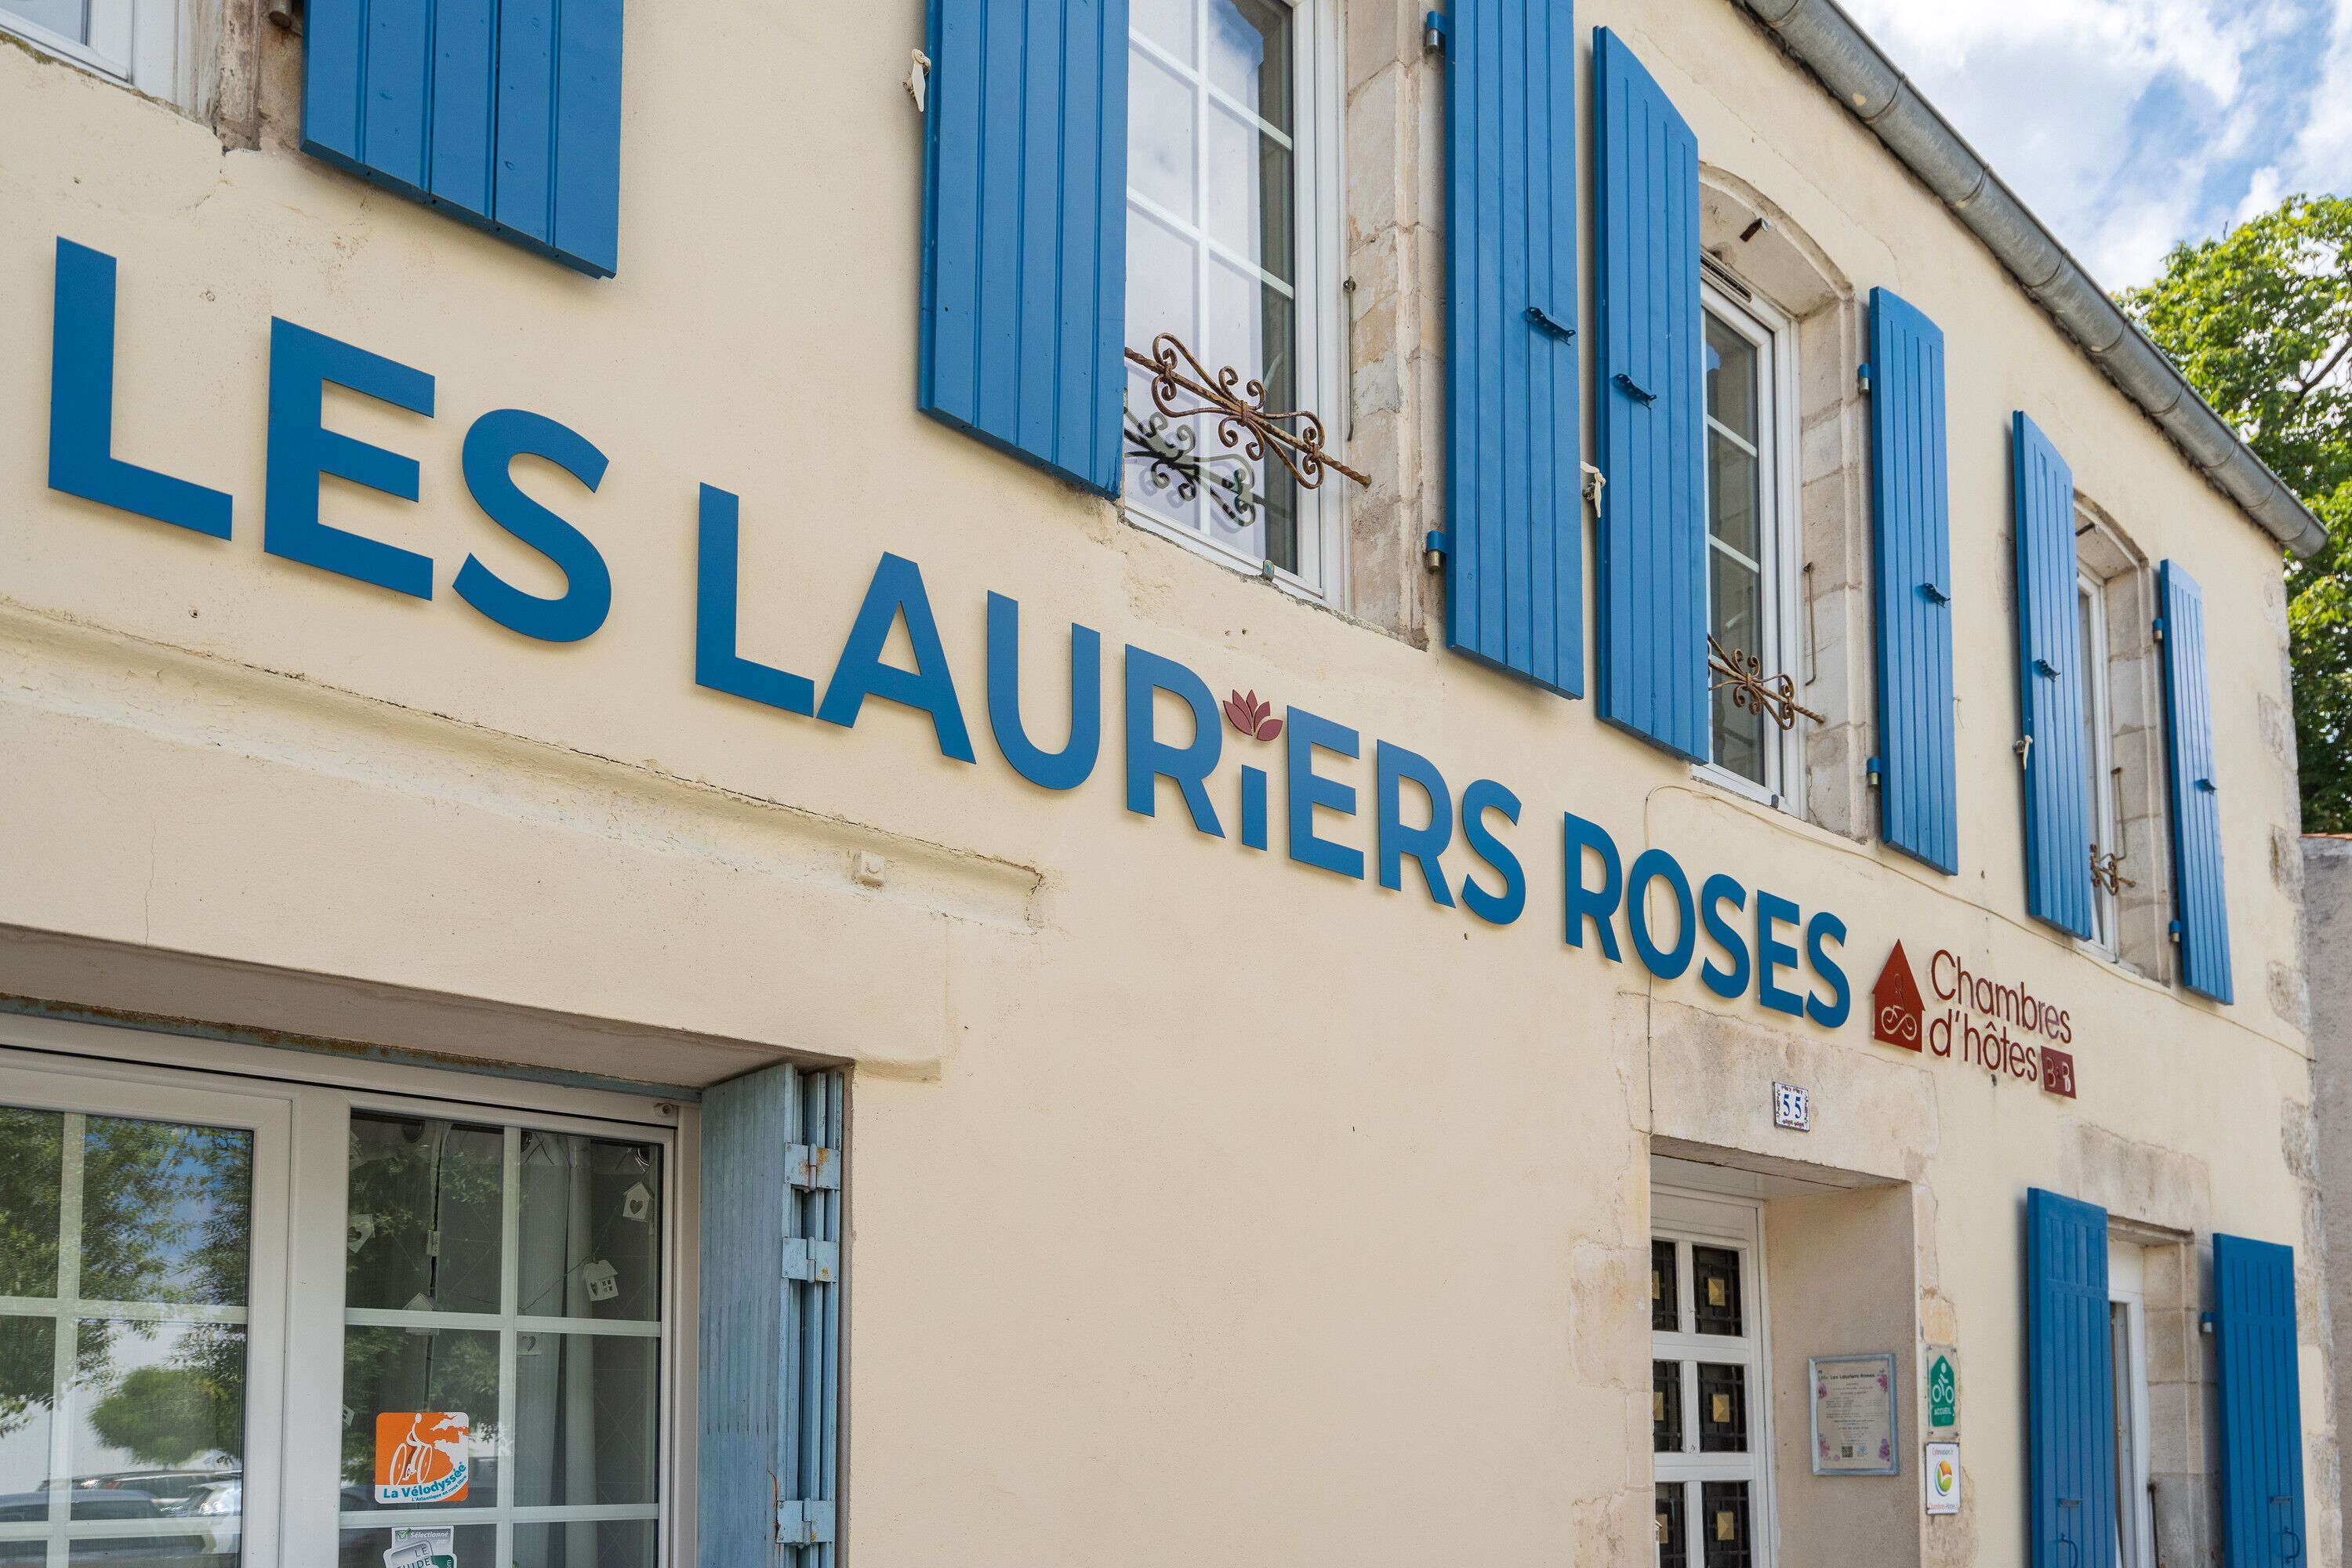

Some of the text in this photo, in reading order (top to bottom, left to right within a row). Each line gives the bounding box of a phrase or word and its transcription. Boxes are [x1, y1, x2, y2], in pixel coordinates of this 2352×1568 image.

[49, 236, 612, 643] LES
[1564, 811, 1851, 1029] ROSES
[1931, 949, 2072, 1044] Chambres
[1929, 1008, 2038, 1083] d'hôtes
[1783, 1094, 1802, 1119] 55
[1934, 1406, 1952, 1416] ACCUEIL
[383, 1488, 399, 1499] La
[412, 1494, 442, 1502] L'Atlantique
[457, 1475, 467, 1487] libre
[410, 1530, 448, 1539] Sélectionné
[415, 1546, 429, 1558] LE
[397, 1557, 431, 1568] IDE
